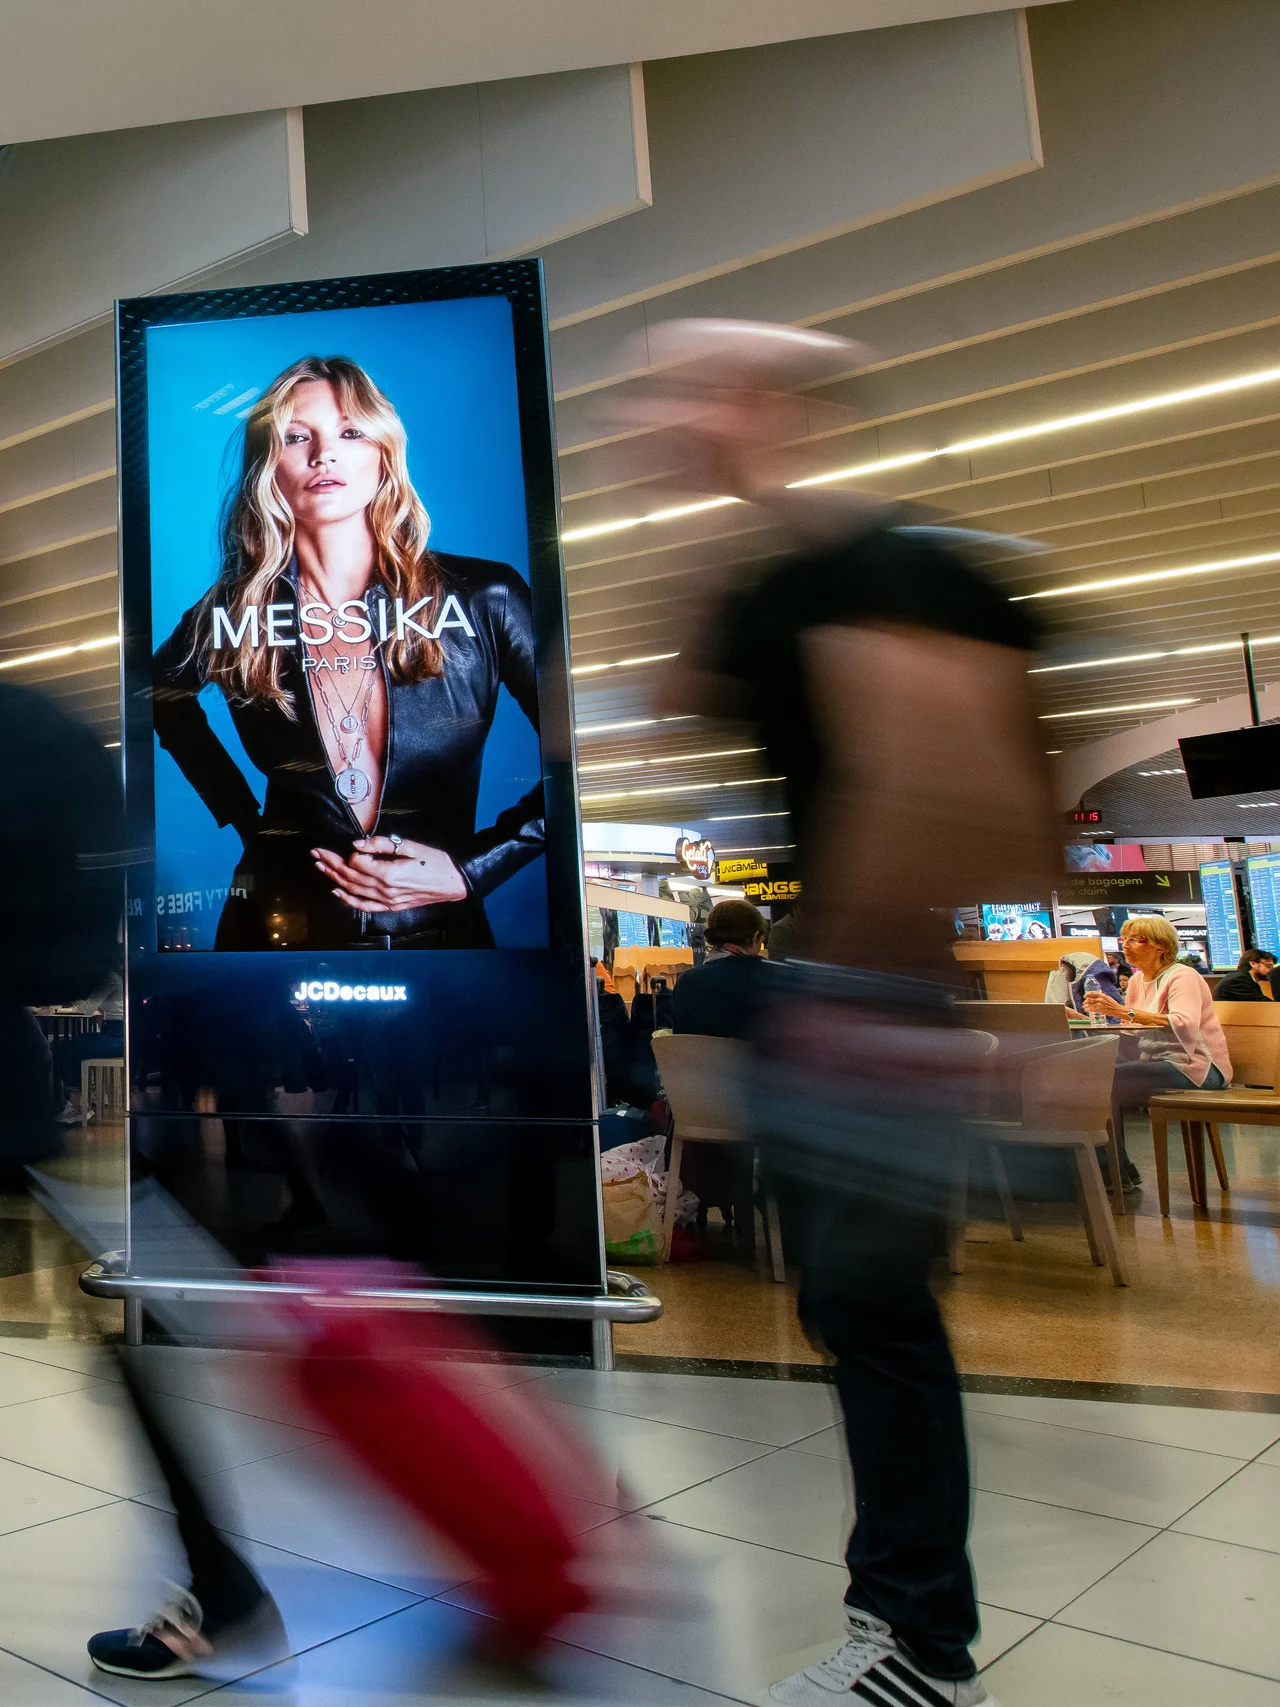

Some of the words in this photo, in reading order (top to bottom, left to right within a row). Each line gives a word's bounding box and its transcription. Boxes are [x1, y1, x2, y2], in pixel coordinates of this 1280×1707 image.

[212, 595, 476, 649] MESSIKA
[302, 655, 377, 672] PARIS
[1088, 877, 1143, 887] bagagem
[1078, 887, 1108, 896] claim
[294, 981, 407, 1001] JCDecaux
